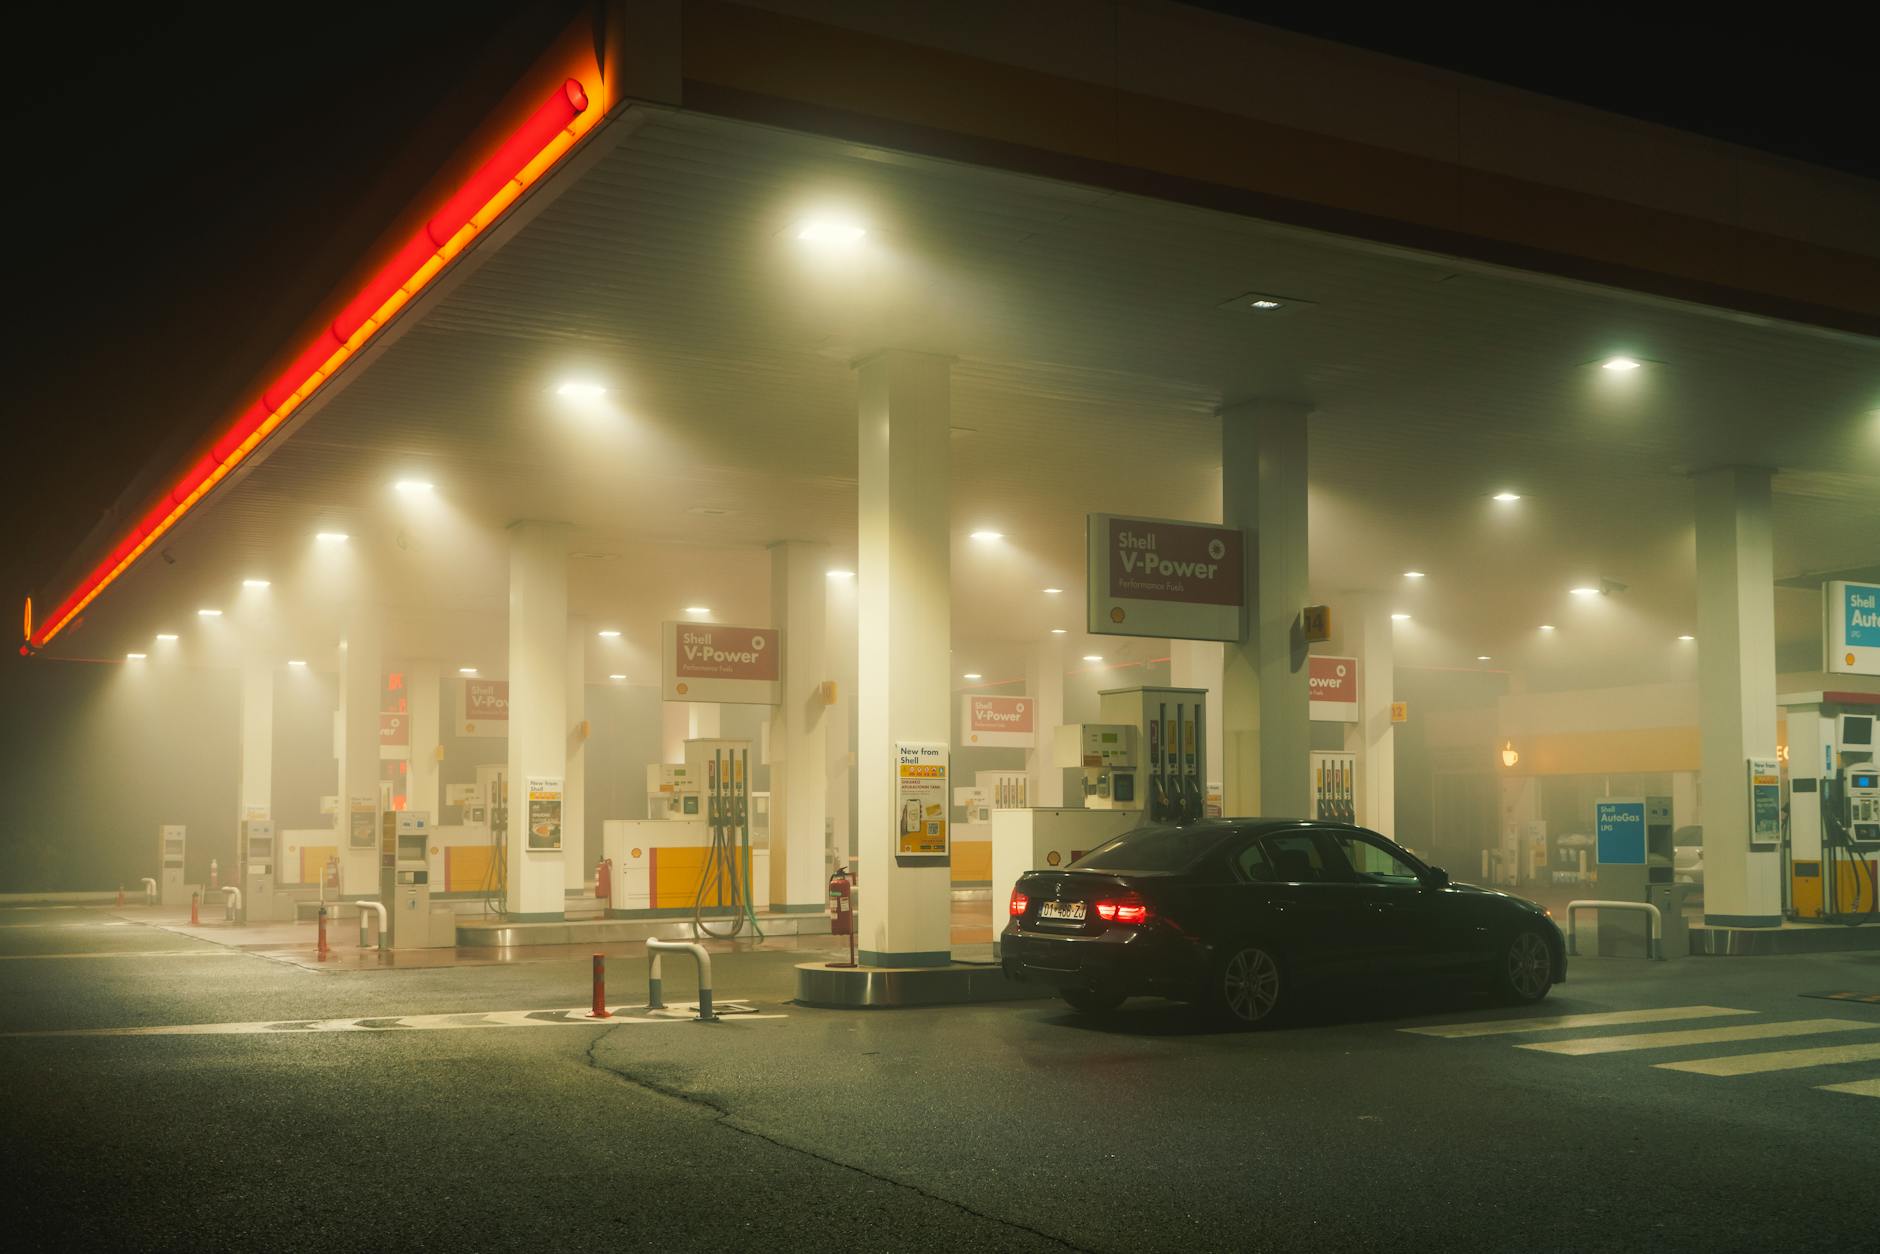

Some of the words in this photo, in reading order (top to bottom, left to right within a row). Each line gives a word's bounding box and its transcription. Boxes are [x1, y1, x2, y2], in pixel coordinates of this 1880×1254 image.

[1119, 531, 1156, 550] Shell
[1120, 550, 1218, 579] V-Power
[1119, 578, 1164, 590] Performance
[1166, 581, 1184, 592] Fuels
[1850, 594, 1875, 608] Shell
[1304, 613, 1325, 633] 14
[683, 632, 712, 645] Shell
[684, 645, 759, 663] V-Power
[471, 686, 494, 696] Shell
[976, 702, 992, 710] Shell
[976, 710, 1022, 721] V-Power
[900, 747, 918, 755] New
[921, 748, 939, 756] from
[1600, 813, 1640, 822] AutoGas
